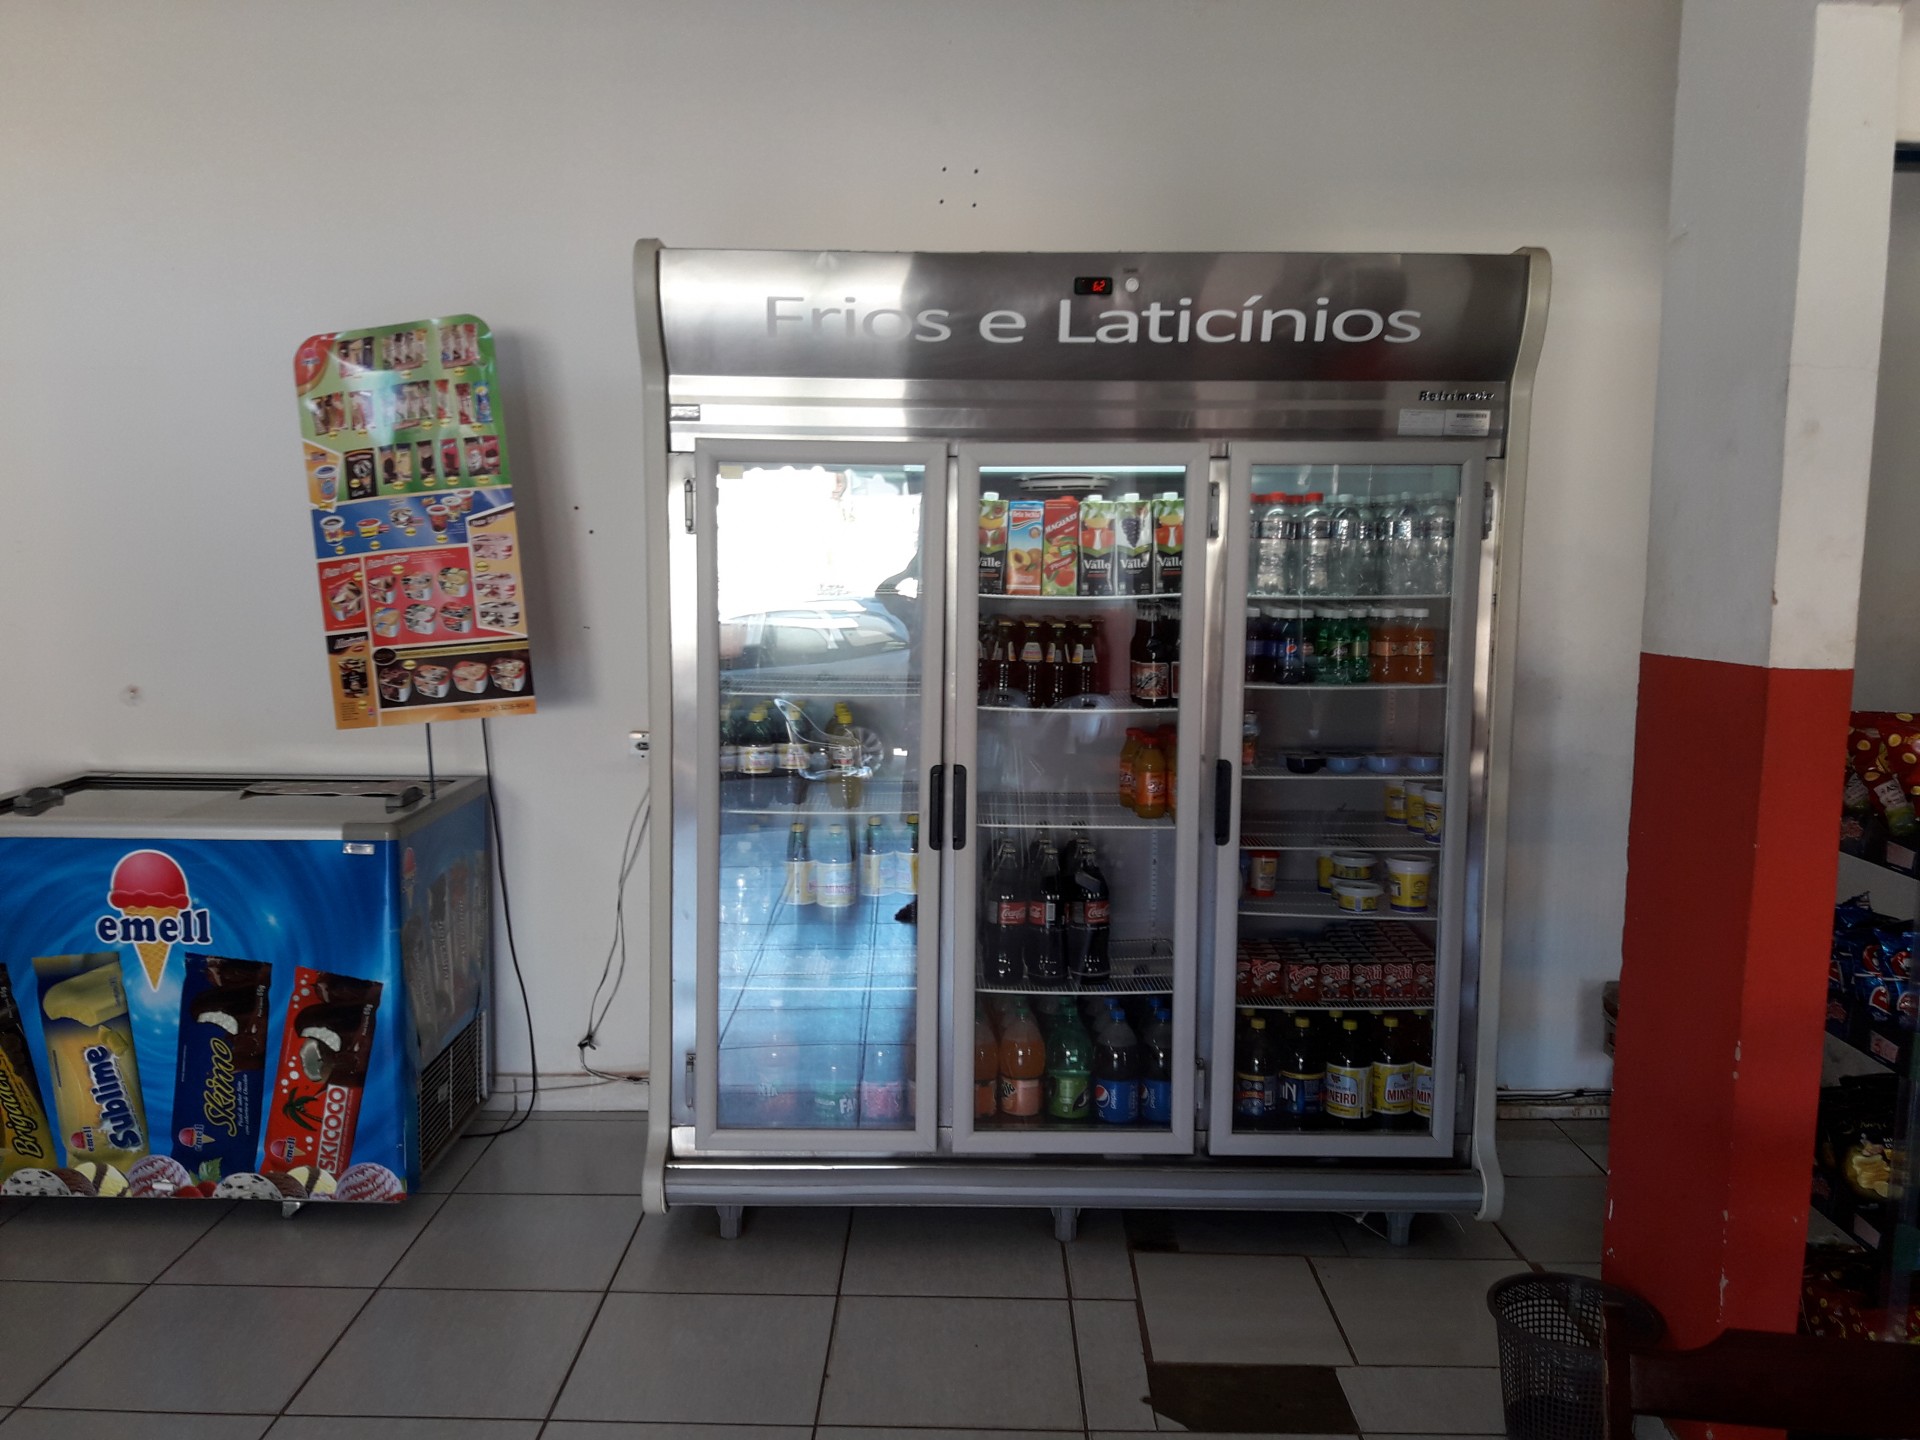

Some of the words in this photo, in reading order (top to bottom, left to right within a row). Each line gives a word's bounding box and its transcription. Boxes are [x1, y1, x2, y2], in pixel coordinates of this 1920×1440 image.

[766, 297, 952, 343] Frios
[979, 309, 1026, 343] e
[1058, 295, 1421, 343] Laticínios
[1120, 559, 1149, 569] Valle
[97, 909, 210, 943] emell
[86, 1045, 142, 1149] Sublime
[203, 1037, 238, 1137] Skimo
[83, 1126, 94, 1152] emell
[319, 1086, 346, 1173] SKICOCO
